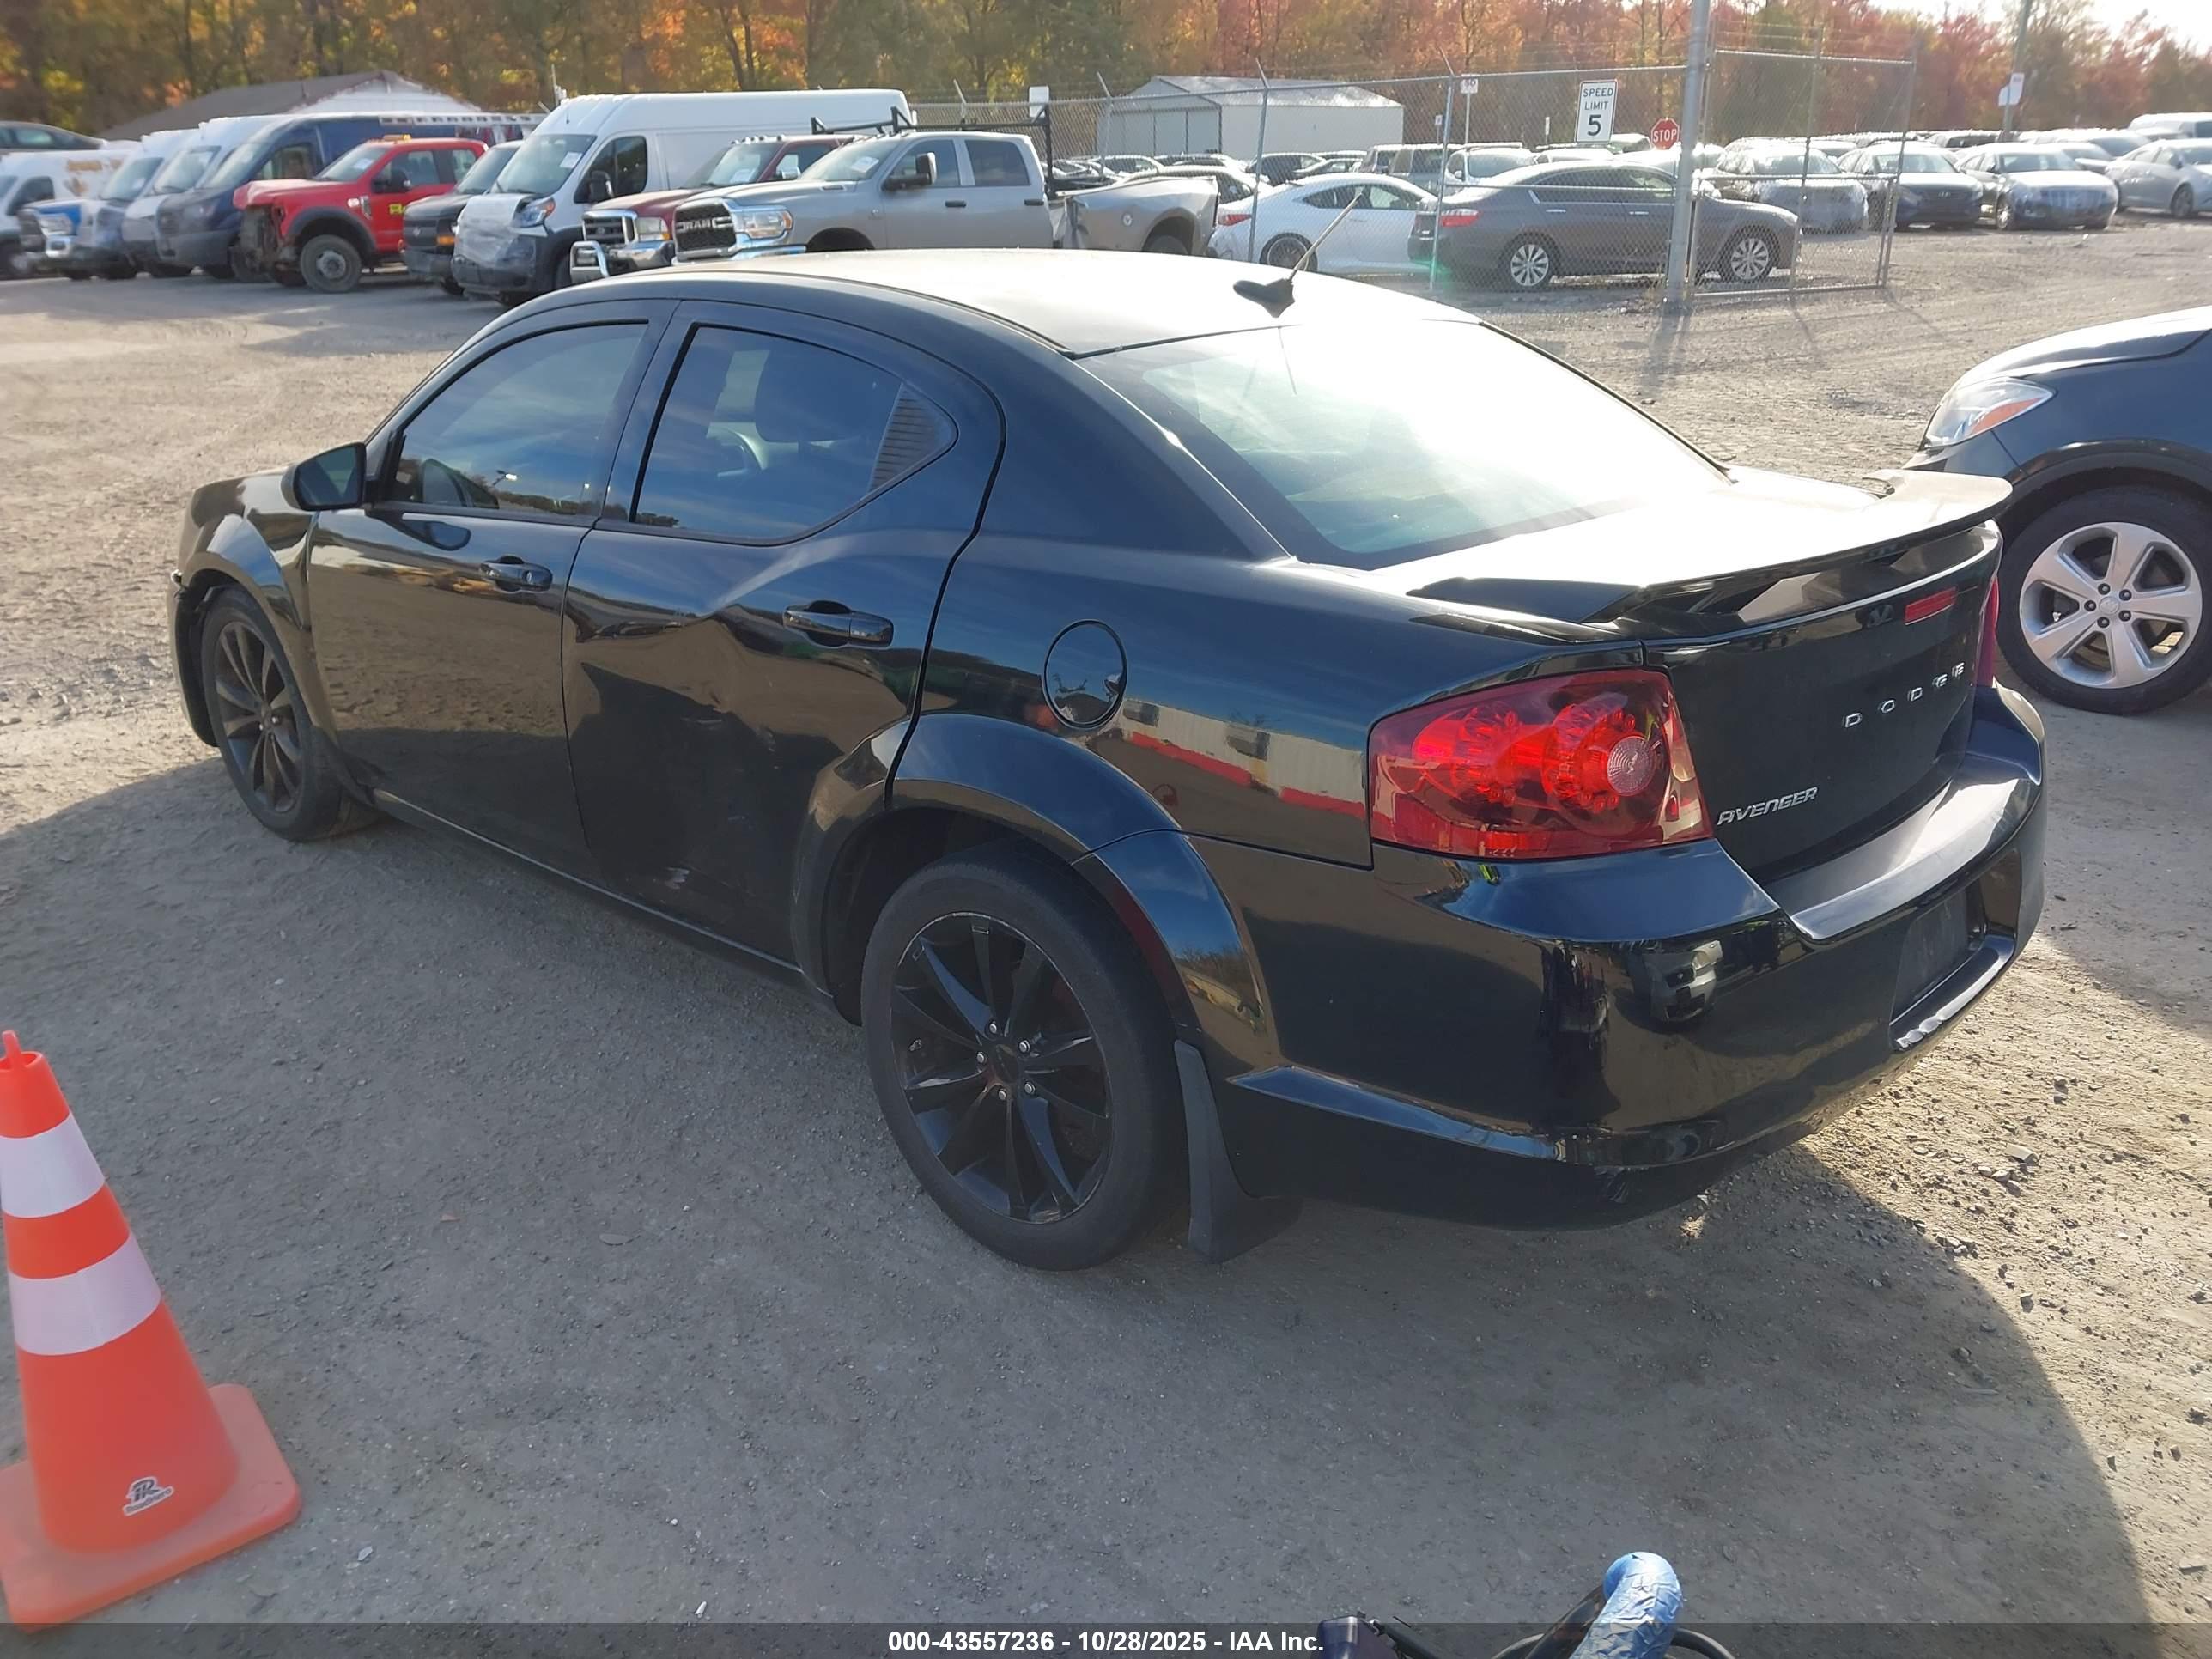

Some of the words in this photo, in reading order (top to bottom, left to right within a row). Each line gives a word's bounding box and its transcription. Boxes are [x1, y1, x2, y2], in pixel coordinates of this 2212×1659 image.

[1583, 88, 1613, 97] SPEED
[1584, 100, 1609, 111] LIMIT
[1587, 114, 1601, 136] 5
[1653, 129, 1677, 143] STOP
[687, 218, 712, 230] RAM
[1844, 662, 1965, 728] DODGE
[1717, 787, 1818, 825] AVENGER
